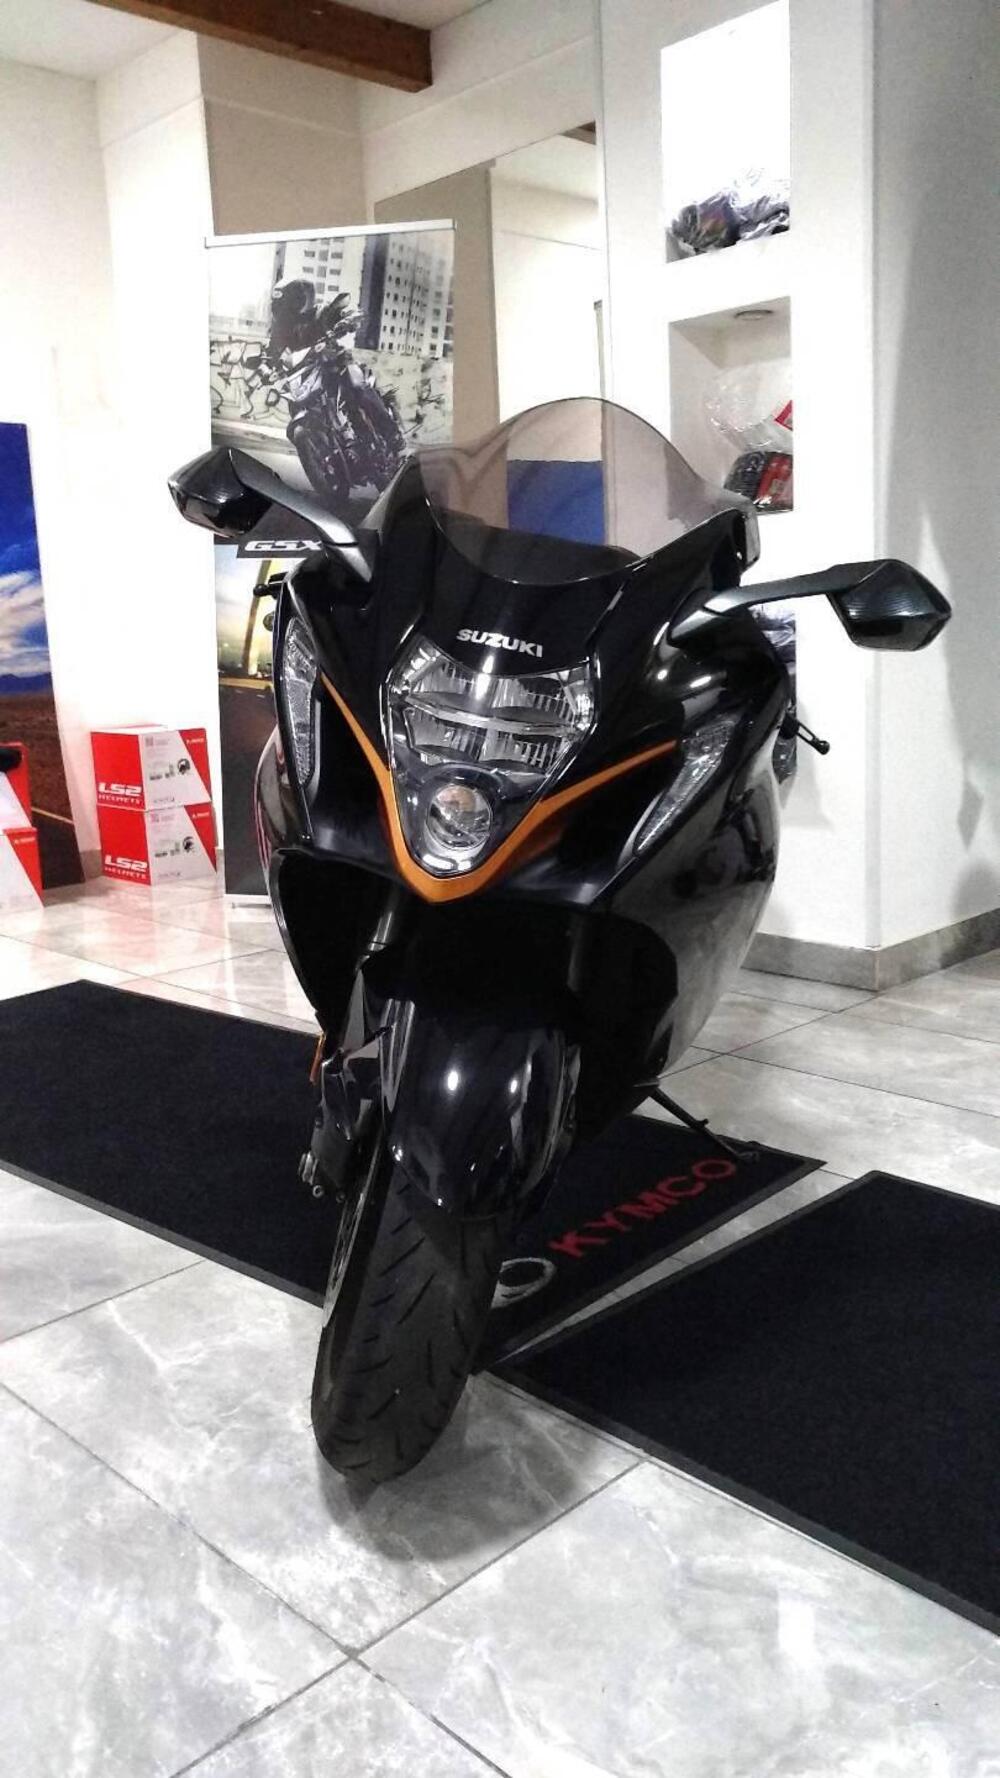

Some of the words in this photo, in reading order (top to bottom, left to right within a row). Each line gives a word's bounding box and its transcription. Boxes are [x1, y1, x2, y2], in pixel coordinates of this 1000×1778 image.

[244, 540, 322, 552] GSX
[456, 628, 543, 658] SUZUKI
[98, 782, 142, 797] LS2
[104, 855, 148, 873] LS2
[547, 1158, 737, 1259] KYMCO
